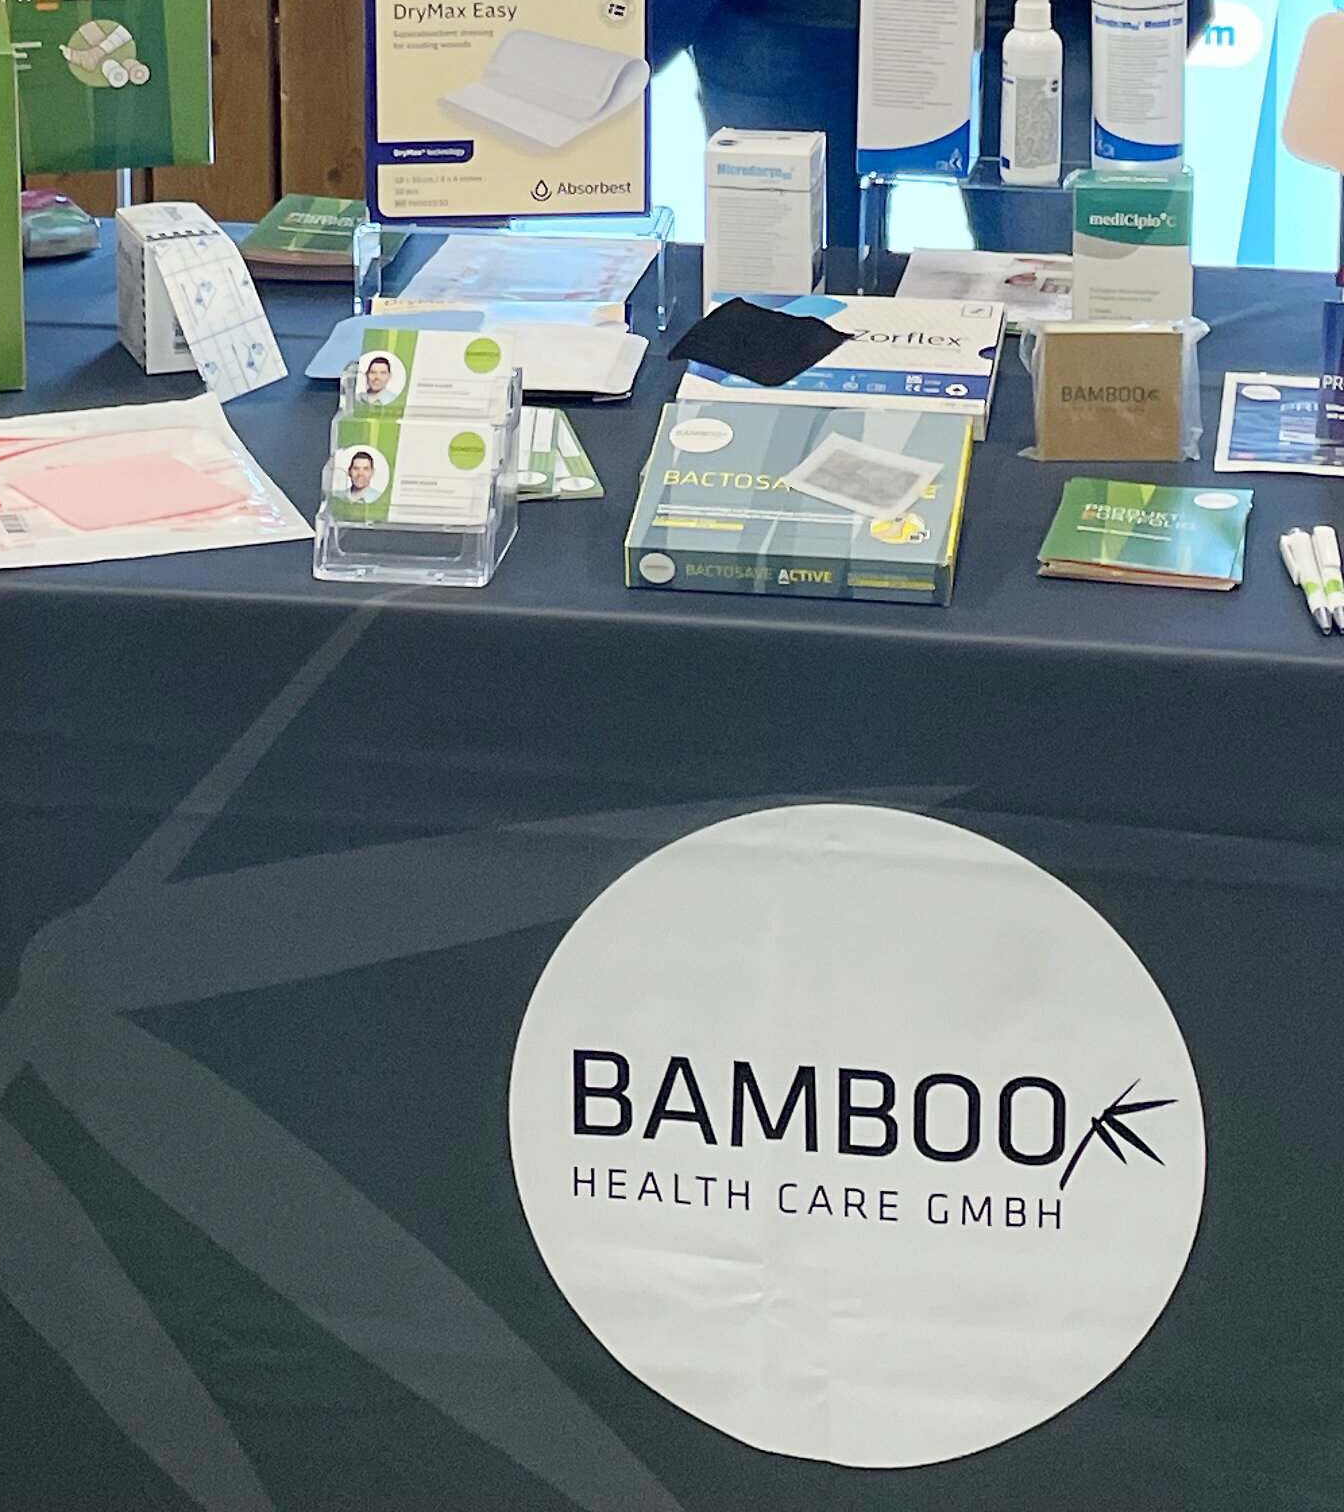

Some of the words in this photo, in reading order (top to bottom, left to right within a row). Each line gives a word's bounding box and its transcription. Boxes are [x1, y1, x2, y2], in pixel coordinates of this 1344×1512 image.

[393, 3, 467, 24] DryMax
[473, 1, 518, 22] Easy
[557, 180, 632, 196] Absorbest
[853, 329, 962, 346] Zorflex
[663, 469, 792, 493] BACTOSA
[573, 1048, 1067, 1167] BAMBOO
[573, 1166, 751, 1212] HEALTH
[777, 1182, 900, 1223] CARE
[927, 1193, 1063, 1230] GMBH
